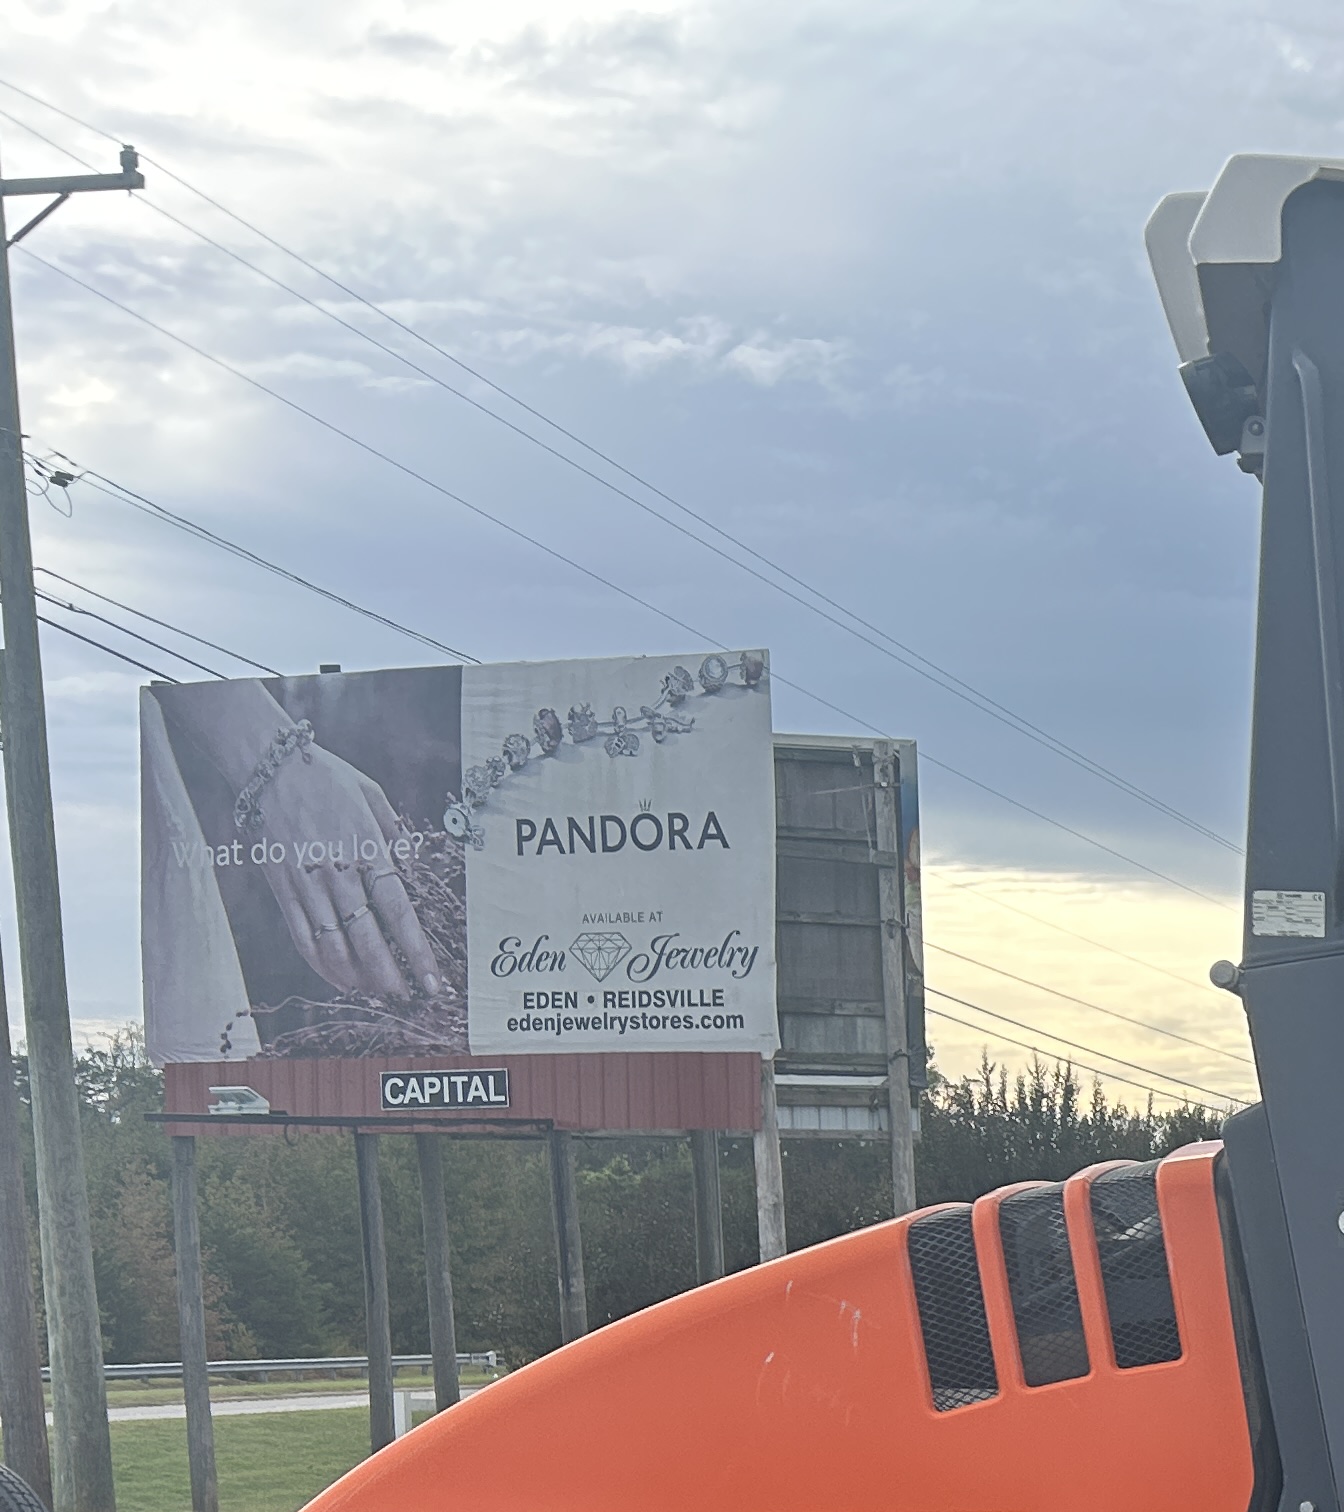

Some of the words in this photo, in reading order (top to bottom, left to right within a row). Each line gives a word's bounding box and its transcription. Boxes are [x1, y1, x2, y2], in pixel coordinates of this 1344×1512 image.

[515, 811, 731, 856] PANDORA
[172, 839, 243, 867] What
[250, 837, 285, 864] do
[293, 839, 343, 868] you
[352, 832, 424, 861] love?
[582, 912, 645, 924] AVAILABLE
[649, 911, 664, 923] AT
[490, 934, 567, 978] Eden
[626, 930, 760, 983] Jewelry
[523, 991, 578, 1010] EDEN
[603, 989, 725, 1009] REIDSVILLE
[506, 1012, 745, 1036] edenjewelrystores.com
[384, 1074, 506, 1105] CAPITAL
